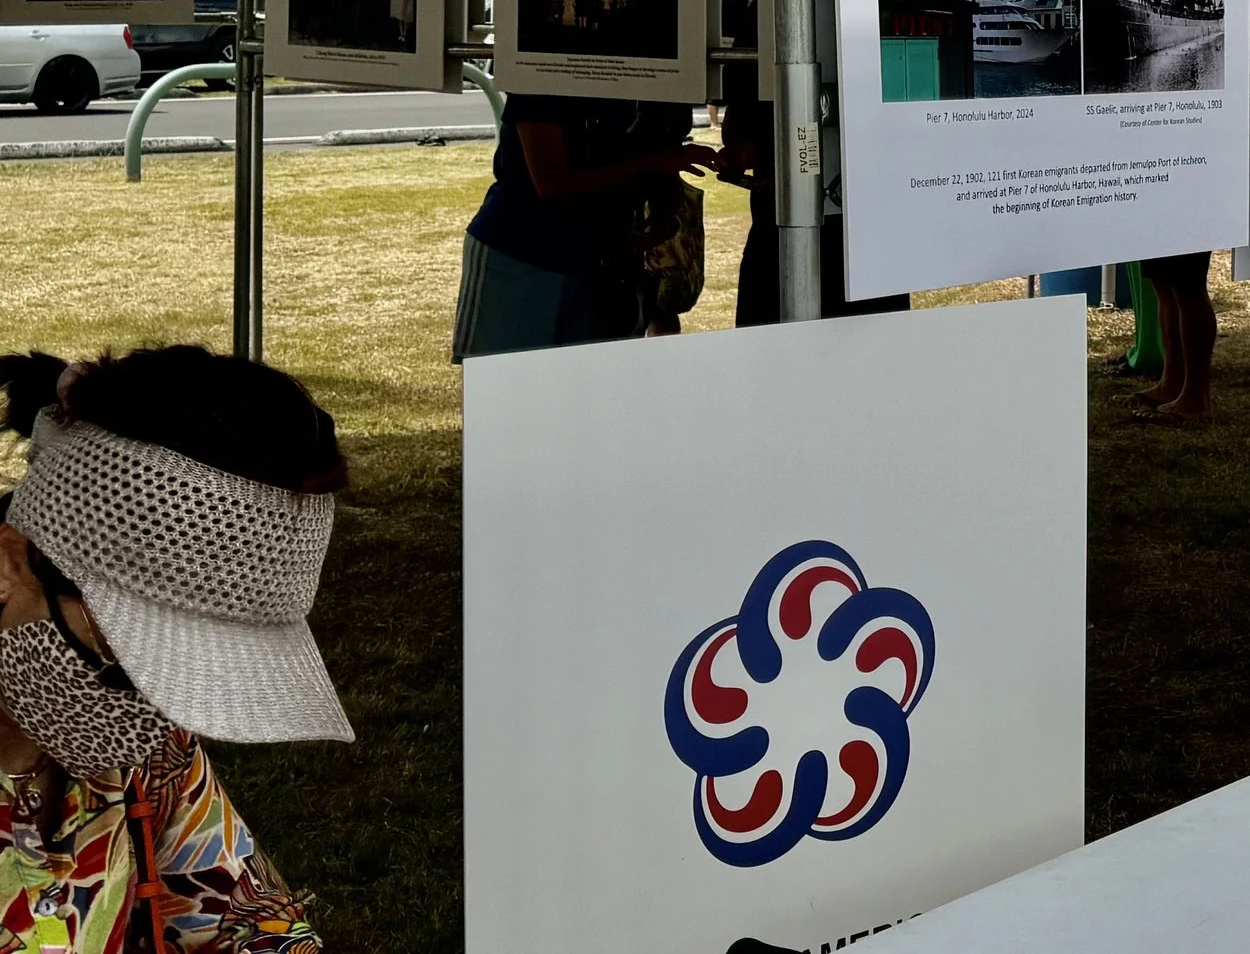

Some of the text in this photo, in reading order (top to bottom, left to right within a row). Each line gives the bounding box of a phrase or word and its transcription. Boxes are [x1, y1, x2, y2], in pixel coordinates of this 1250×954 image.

[926, 112, 941, 123] Pier
[952, 110, 986, 122] Honolulu
[1016, 108, 1034, 118] 2024
[1086, 105, 1094, 115] SS
[1119, 103, 1145, 114] arriving
[1146, 103, 1152, 112] at
[1154, 102, 1166, 111] Pier
[1207, 99, 1222, 109] 1903
[797, 126, 808, 173] FVOL-EZ
[910, 175, 949, 188] December
[988, 170, 1000, 181] 121
[1002, 169, 1016, 180] first
[1018, 169, 1043, 179] Korean
[1044, 166, 1078, 178] emigrants
[1079, 161, 1110, 175] departed
[1111, 161, 1128, 171] from
[1129, 158, 1156, 170] Jemulpo
[1157, 157, 1171, 167] Port
[1172, 156, 1179, 166] of
[956, 190, 970, 201] and
[971, 187, 997, 199] arrived
[999, 187, 1006, 197] at
[1008, 186, 1022, 196] Pier
[1024, 184, 1028, 194] 7
[1030, 183, 1037, 194] of
[1039, 181, 1070, 193] Honolulu
[1124, 174, 1143, 185] which
[1144, 172, 1169, 183] marked
[992, 203, 1004, 214] the
[1005, 201, 1040, 214] beginning
[1041, 197, 1049, 209] of
[1050, 198, 1075, 208] Korean
[1076, 193, 1112, 206] Emigration
